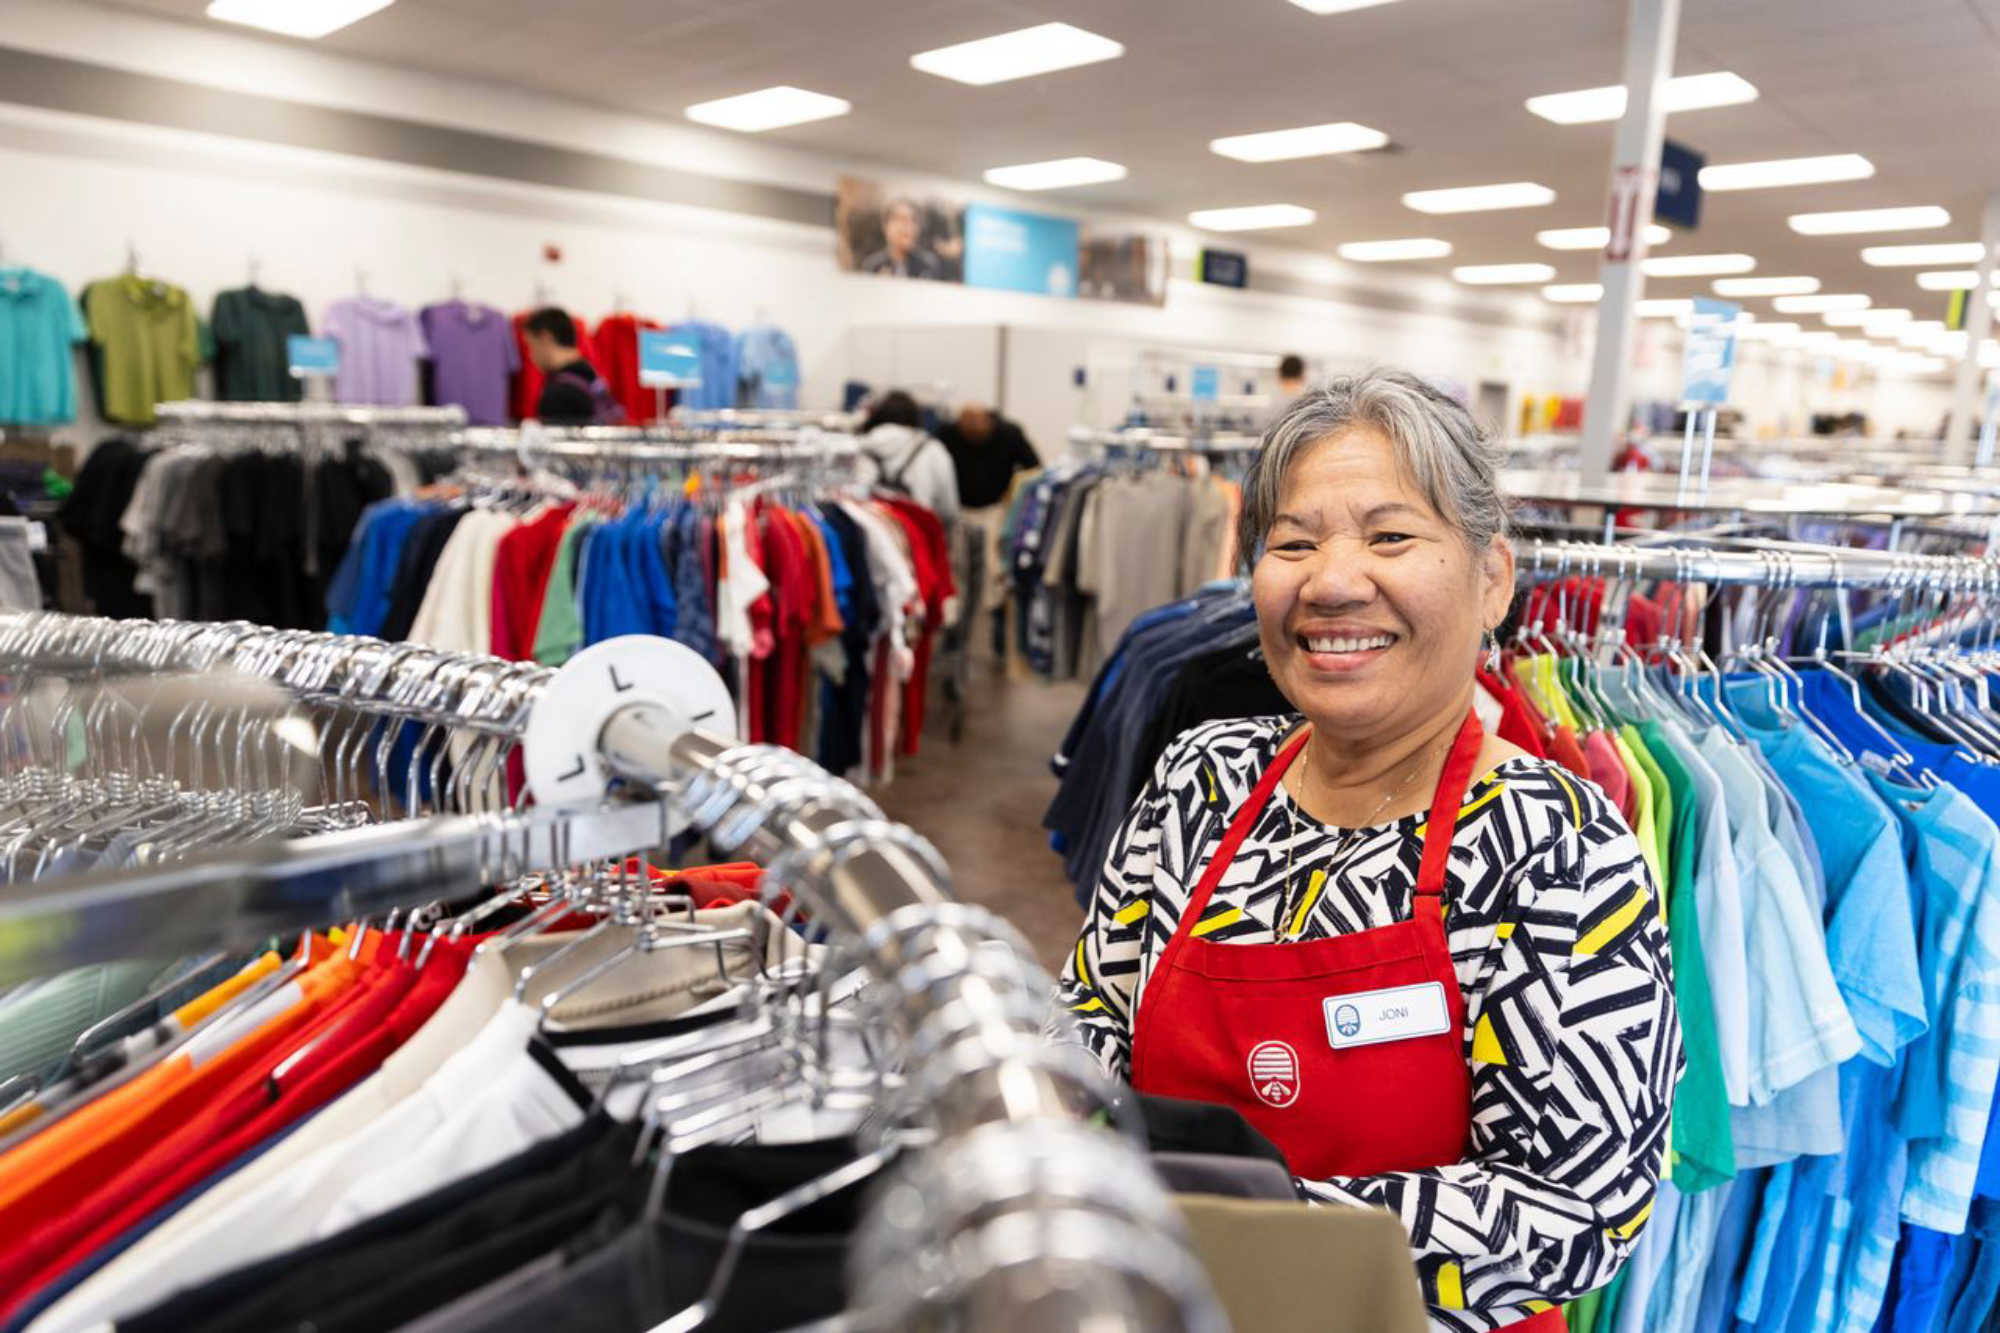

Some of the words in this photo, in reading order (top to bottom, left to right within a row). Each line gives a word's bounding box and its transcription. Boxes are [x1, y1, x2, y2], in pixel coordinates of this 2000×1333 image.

[608, 664, 633, 693] L
[557, 753, 585, 783] L
[1379, 1007, 1409, 1021] JONI
